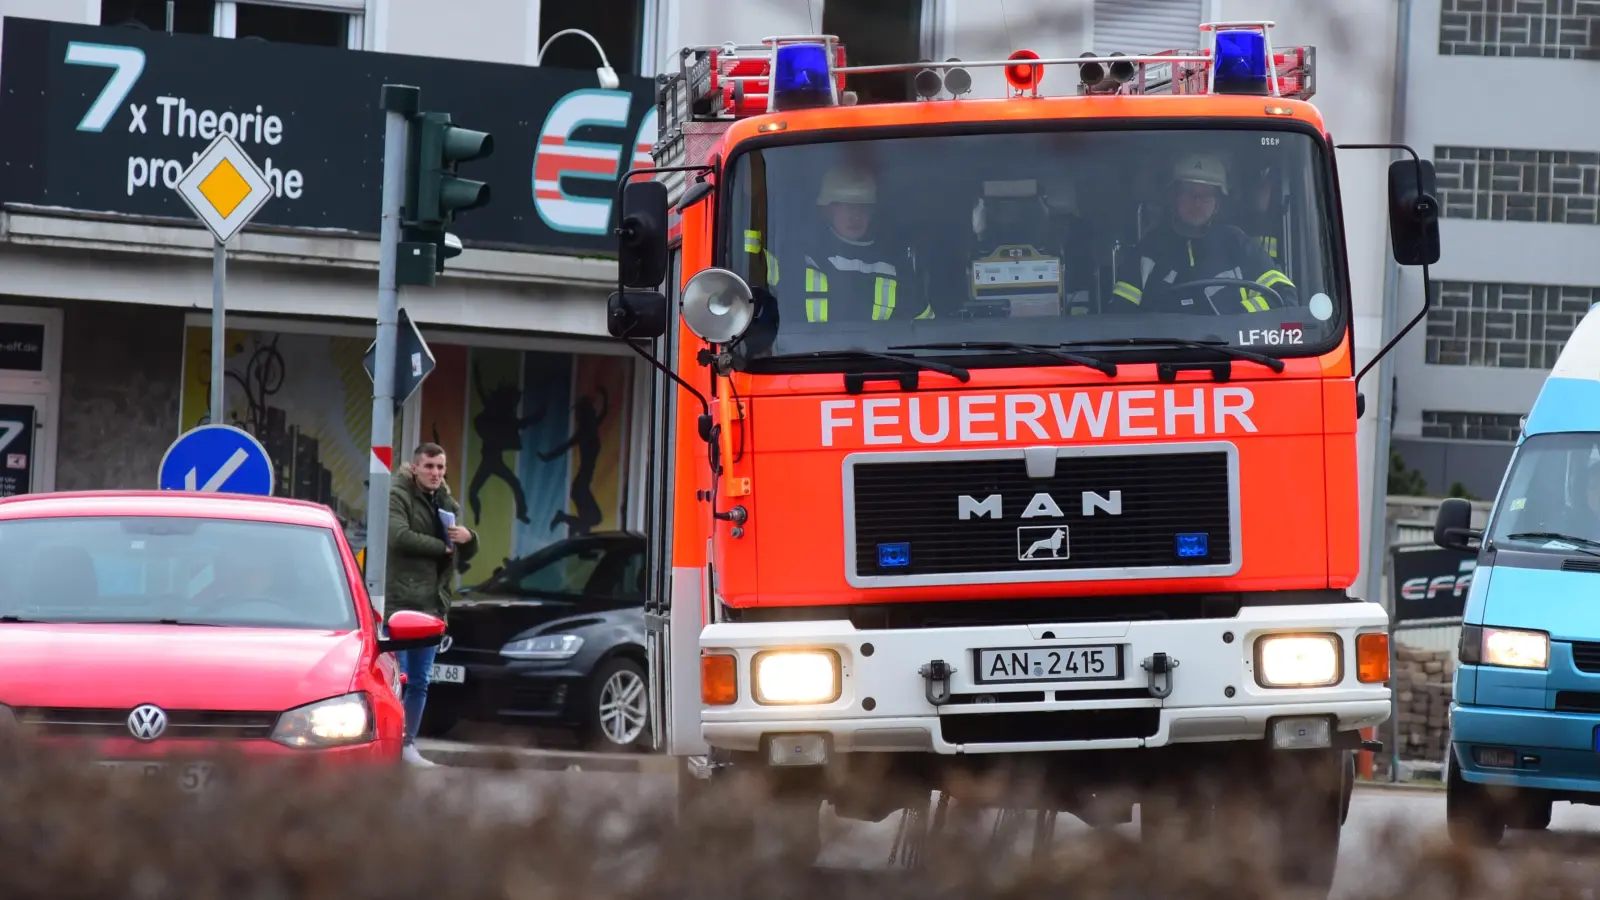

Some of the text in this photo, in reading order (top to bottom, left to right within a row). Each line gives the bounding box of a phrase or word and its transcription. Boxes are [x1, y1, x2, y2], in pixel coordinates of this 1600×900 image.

[64, 41, 284, 145] 7 x Theorie
[127, 156, 183, 196] pro
[821, 387, 1258, 447] FEUERWEHR
[958, 490, 1122, 520] MAN
[990, 650, 1105, 677] AN-2415
